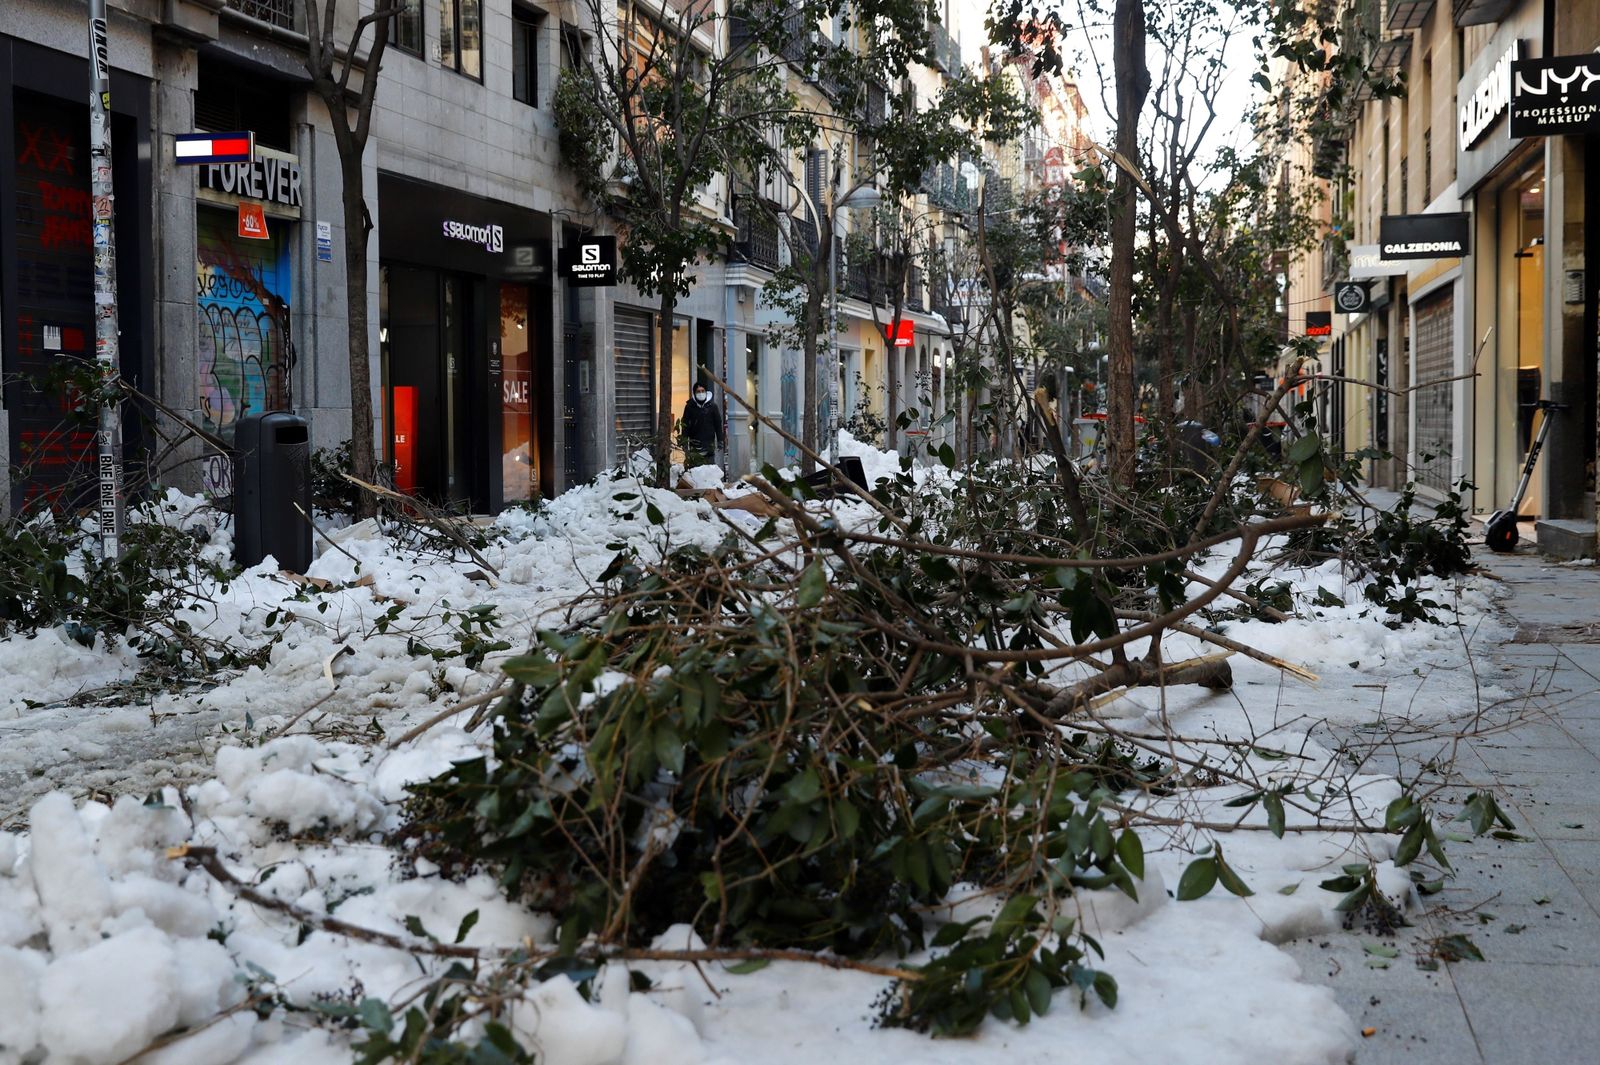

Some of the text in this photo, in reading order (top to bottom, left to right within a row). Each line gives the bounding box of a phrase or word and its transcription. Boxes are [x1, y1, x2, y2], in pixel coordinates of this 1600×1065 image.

[1460, 39, 1518, 152] CALZEDON
[1515, 104, 1600, 118] PROFESSION
[1537, 113, 1591, 125] MAKEUP
[208, 156, 302, 206] FOREVER
[1384, 241, 1461, 254] CALZEDONIA
[503, 380, 528, 403] SALE
[395, 434, 405, 443] LE
[100, 455, 115, 534] BNE BNE BNE
